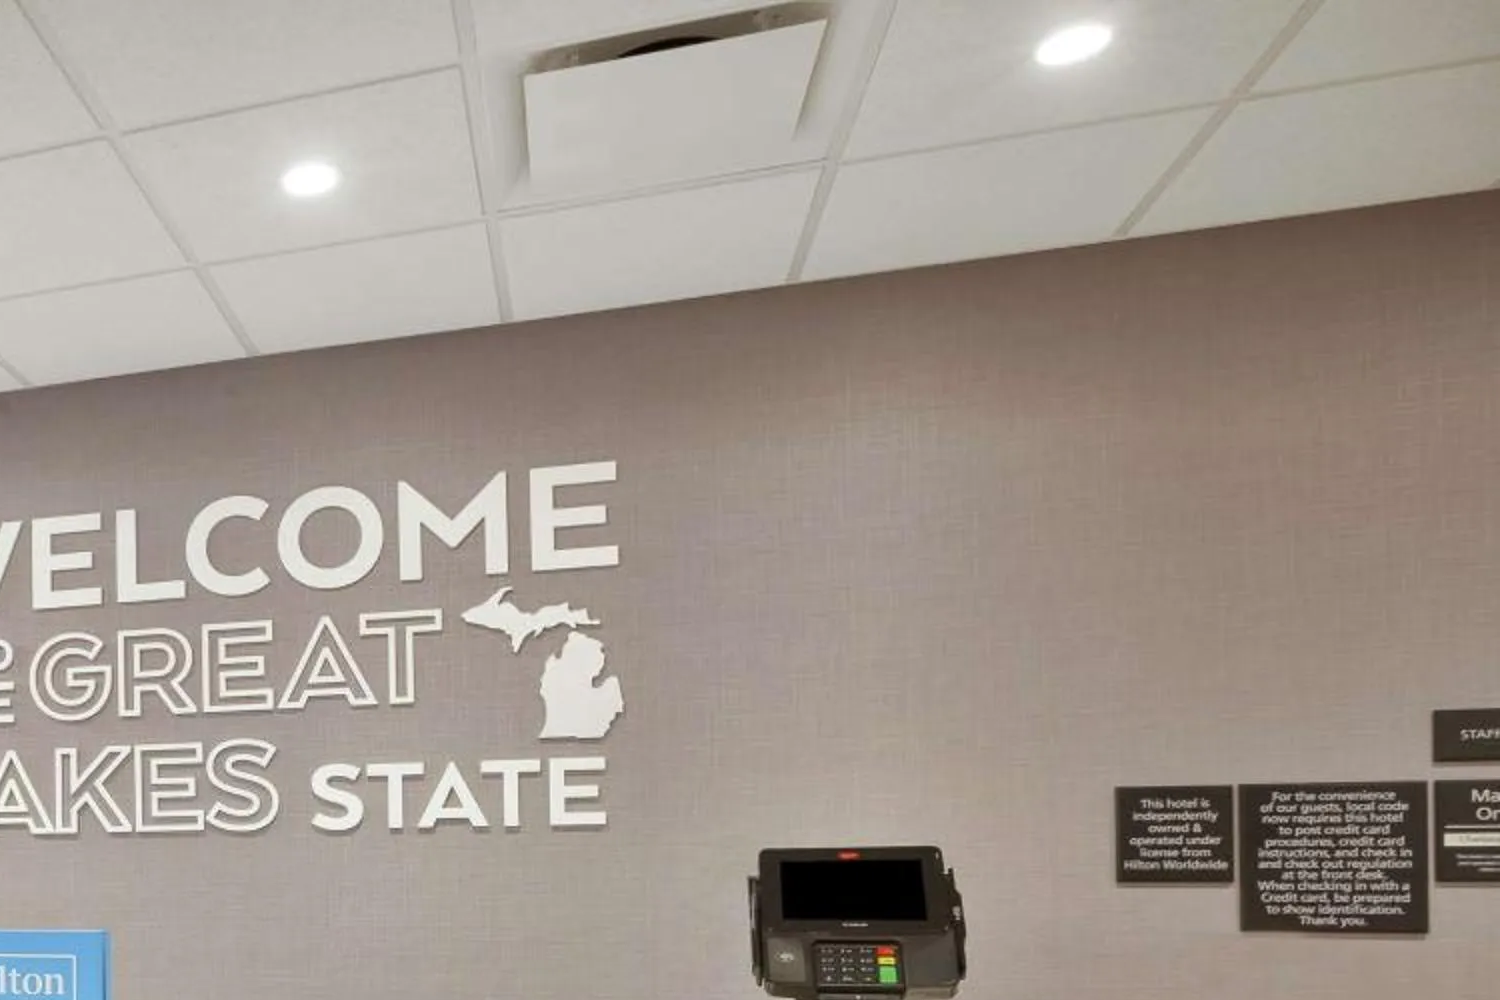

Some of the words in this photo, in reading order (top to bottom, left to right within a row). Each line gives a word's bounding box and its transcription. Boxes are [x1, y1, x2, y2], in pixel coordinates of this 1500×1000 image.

[29, 608, 443, 721] GREAT
[310, 757, 608, 832] STATE
[1272, 791, 1293, 801] For
[1295, 791, 1316, 801] the
[1318, 791, 1397, 801] convenience
[1140, 798, 1164, 809] This
[1166, 798, 1198, 809] hotel
[1260, 802, 1273, 813] of
[1276, 804, 1297, 813] our
[1346, 802, 1376, 813] local
[1378, 802, 1409, 813] code
[1133, 811, 1218, 823] independently
[1262, 815, 1289, 823] now
[1345, 813, 1368, 823] this
[1370, 813, 1404, 823] hotel
[1148, 823, 1189, 833] owned
[1279, 825, 1292, 836] to
[1295, 825, 1321, 836] post
[1324, 825, 1360, 836] credit
[1363, 825, 1391, 836] card
[1129, 835, 1184, 846] operated
[1185, 835, 1221, 846] under
[1339, 836, 1374, 847] credit
[1378, 836, 1405, 847] card
[1182, 847, 1212, 857] from
[1334, 848, 1359, 858] and
[1361, 848, 1396, 858] check
[1400, 848, 1412, 858] in
[1124, 860, 1160, 870] Hilton
[1162, 860, 1229, 870] Worldwide
[1258, 859, 1282, 869] and
[1284, 859, 1319, 869] check
[1321, 859, 1343, 869] out
[1281, 870, 1294, 880] at
[1297, 870, 1318, 880] the
[1321, 870, 1353, 880] front
[1257, 881, 1295, 891] When
[1297, 881, 1352, 891] checking
[1355, 881, 1367, 891] in
[1370, 881, 1399, 891] with
[1283, 904, 1316, 915] show
[1300, 916, 1338, 927] Thank
